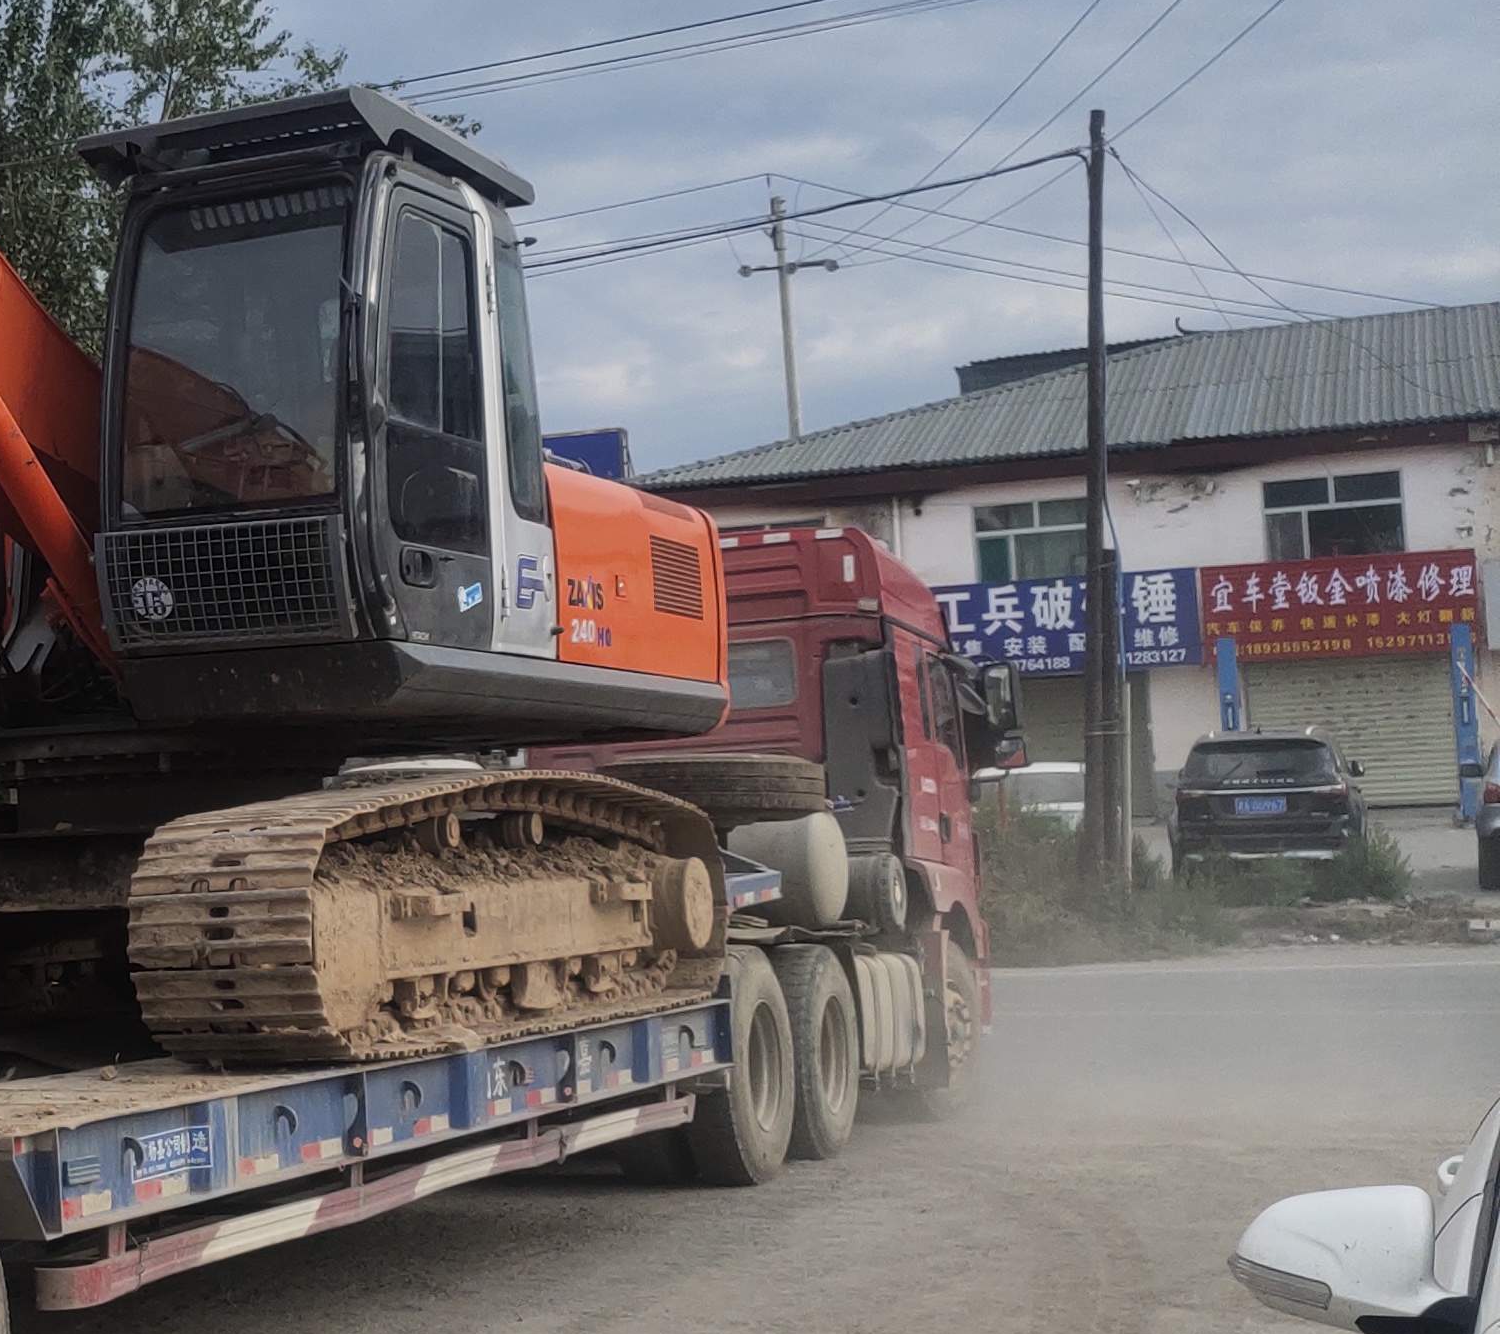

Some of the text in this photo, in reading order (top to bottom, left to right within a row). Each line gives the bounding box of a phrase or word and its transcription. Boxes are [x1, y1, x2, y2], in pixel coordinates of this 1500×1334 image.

[935, 572, 1177, 636] 工兵破锤
[571, 618, 597, 644] 240
[1003, 636, 1047, 657] 安装
[1134, 626, 1180, 648] 维修
